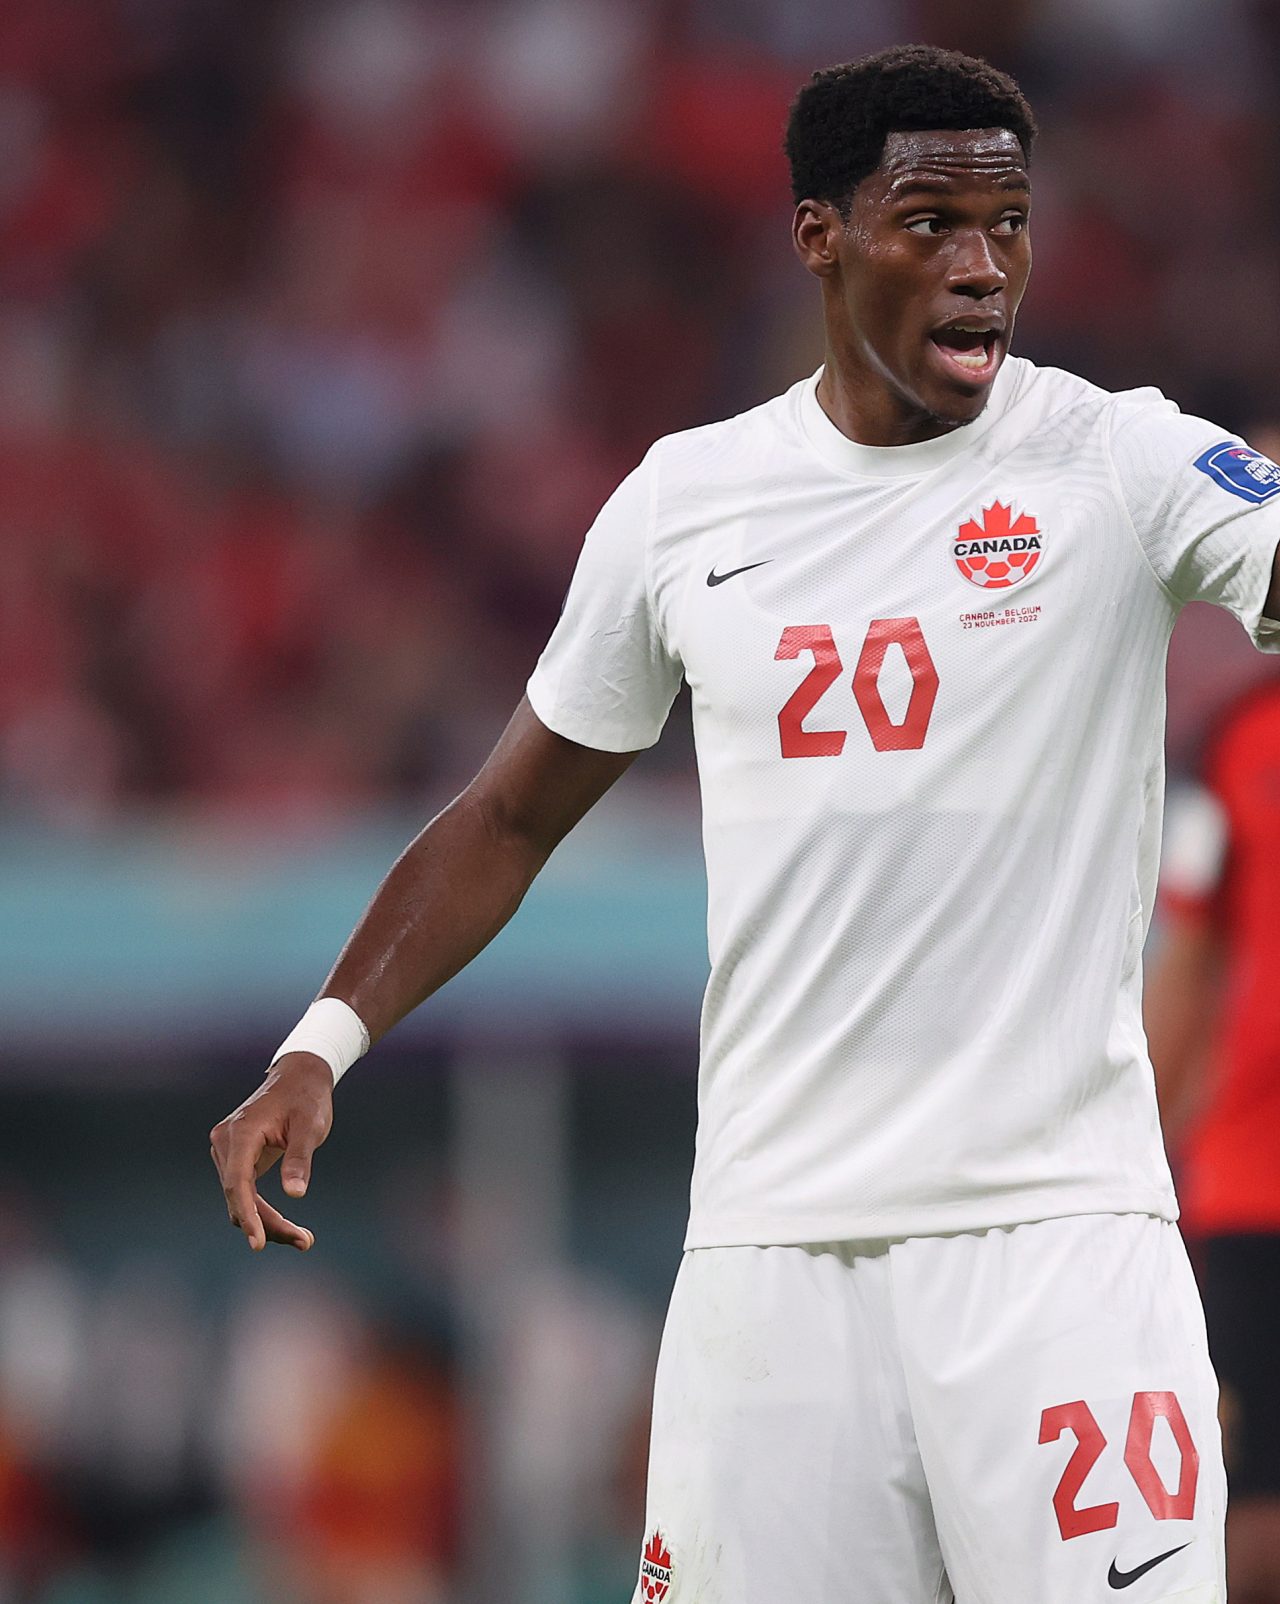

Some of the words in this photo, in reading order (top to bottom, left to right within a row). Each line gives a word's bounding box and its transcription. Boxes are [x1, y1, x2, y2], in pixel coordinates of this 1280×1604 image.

[954, 536, 1041, 556] CANADA
[959, 611, 995, 622] CANADA
[1004, 606, 1042, 617] BELGIUM
[975, 617, 1016, 628] NOVEMBER
[1018, 614, 1038, 623] 2022
[774, 616, 940, 759] 20
[1038, 1391, 1200, 1541] 20
[642, 1561, 671, 1582] CANADA
